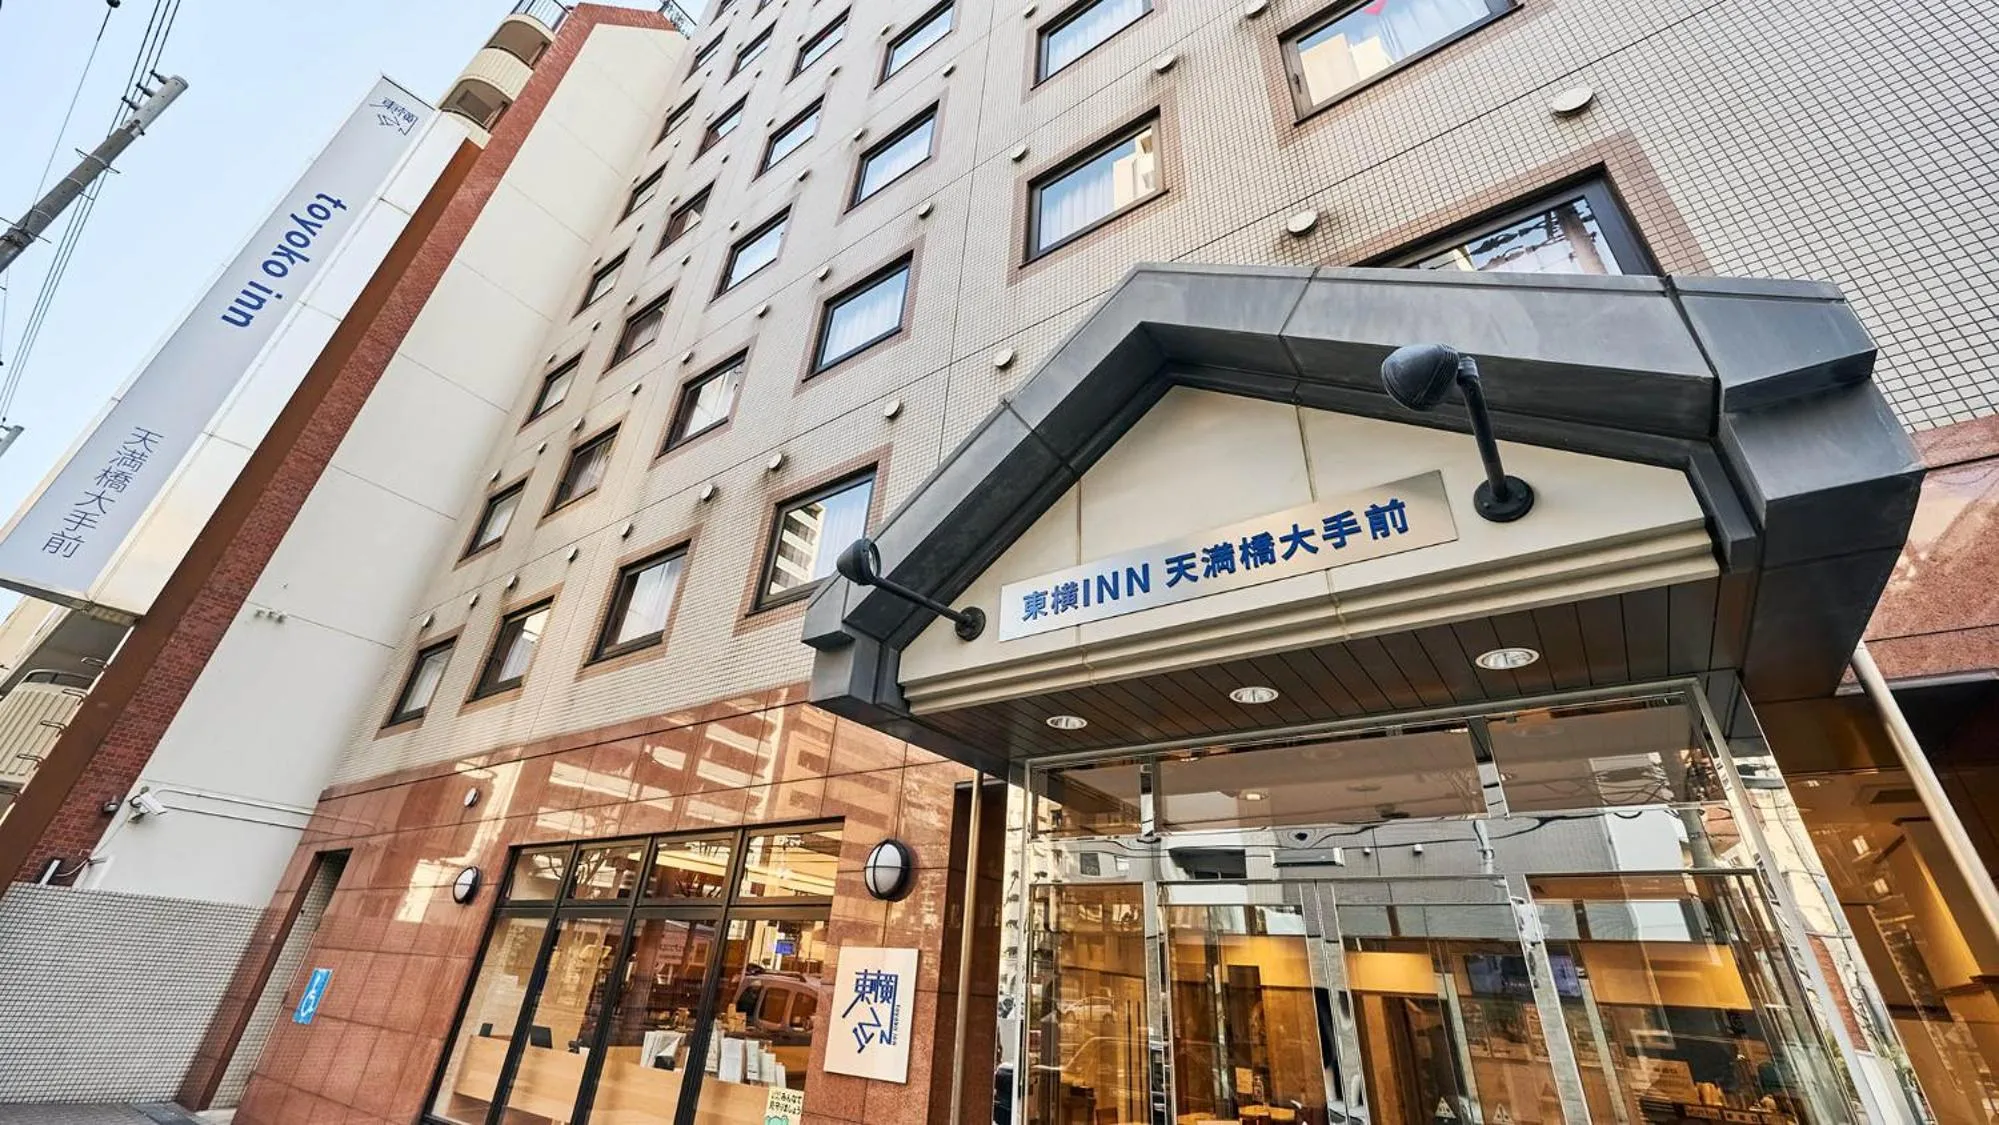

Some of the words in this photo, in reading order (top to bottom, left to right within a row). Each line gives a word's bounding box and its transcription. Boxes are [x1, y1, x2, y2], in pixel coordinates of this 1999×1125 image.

[261, 192, 347, 278] toyoko
[221, 280, 283, 327] inn
[42, 426, 164, 558] 天満橋大手前
[1021, 562, 1151, 622] 東横INN
[1164, 498, 1409, 589] 天満橋大手前
